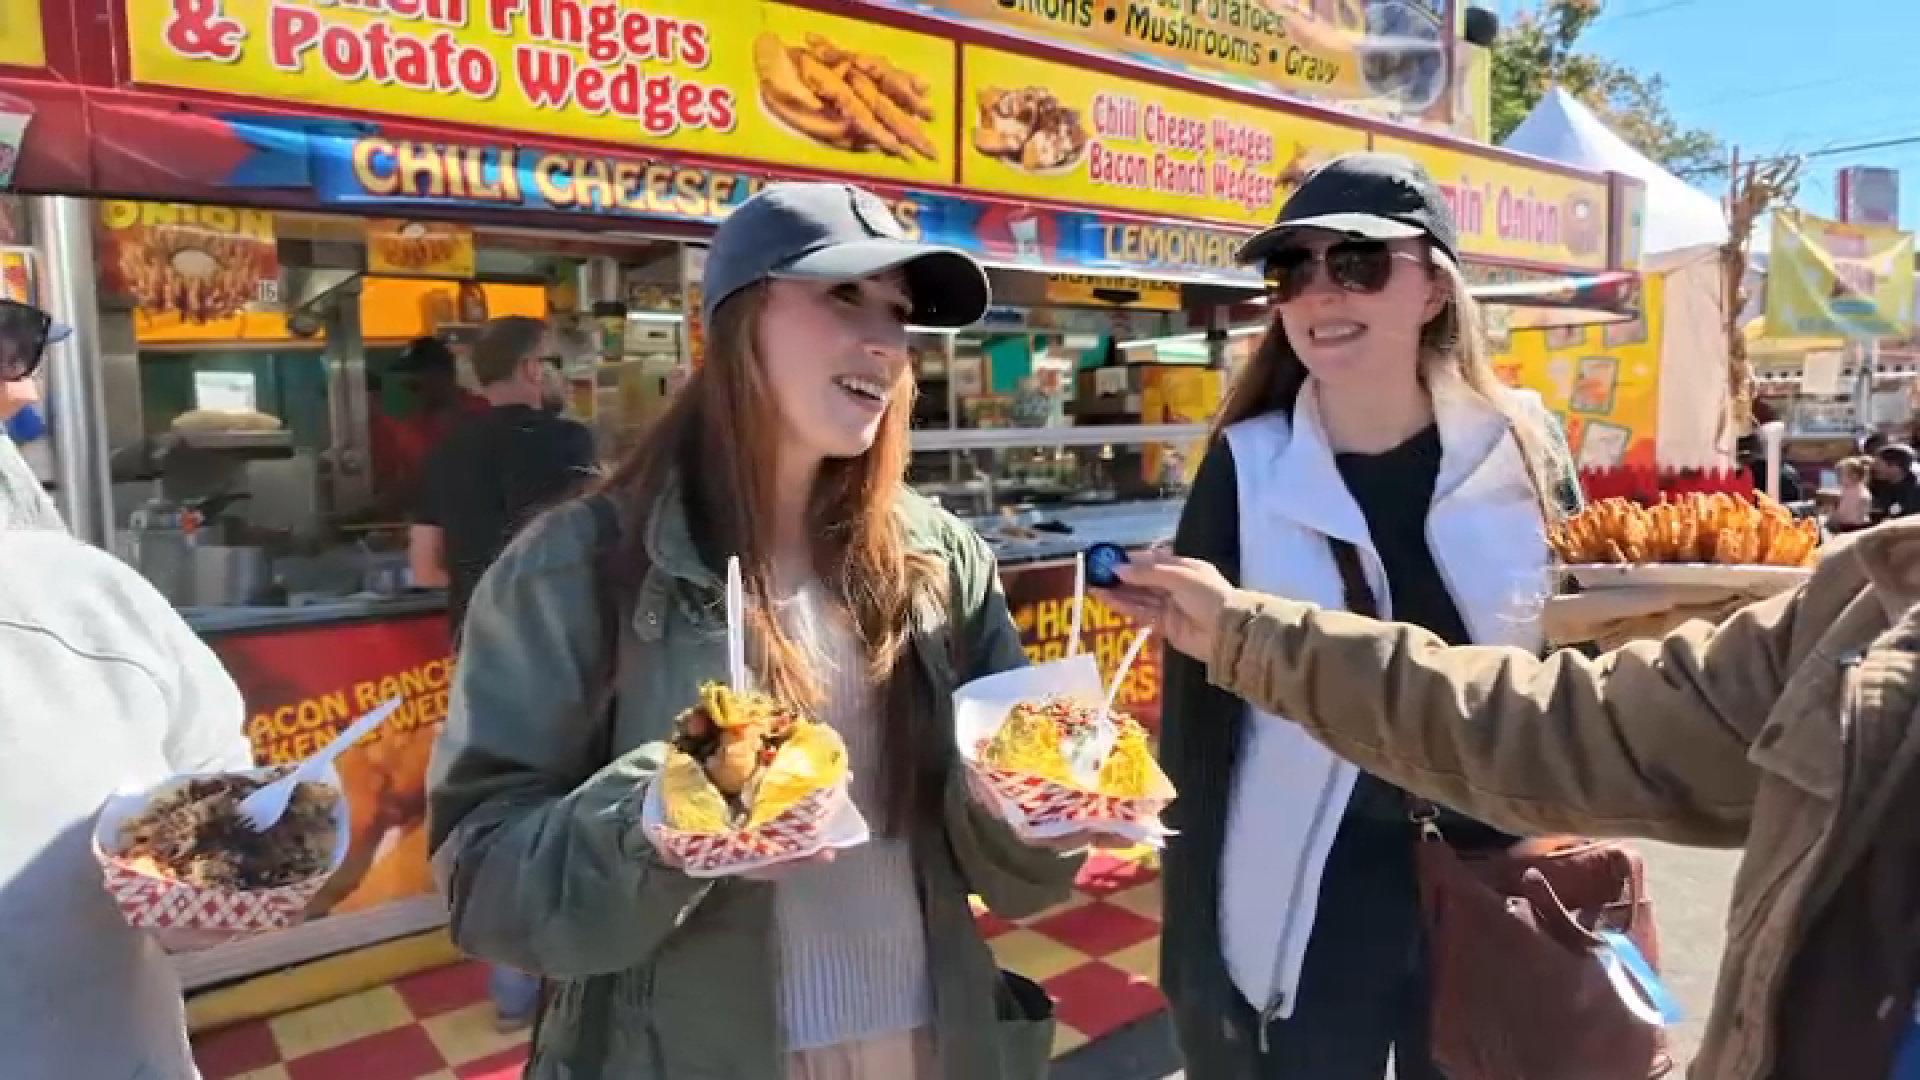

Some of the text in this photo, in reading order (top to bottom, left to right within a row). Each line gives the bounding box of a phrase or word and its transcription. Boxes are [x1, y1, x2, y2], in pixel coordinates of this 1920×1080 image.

[166, 0, 734, 133] & Potato Wedges
[489, 0, 706, 65] Fingers
[1002, 0, 1093, 27] nions
[1124, 3, 1261, 66] Mushrooms
[1284, 45, 1341, 84] Gravy
[1091, 92, 1276, 166] Chili Cheese Wedges
[352, 136, 520, 202] CHILI
[533, 153, 737, 217] CHEESE
[1089, 140, 1277, 211] Bacon Ranch Wedges
[1497, 185, 1559, 243] Onion
[1037, 594, 1126, 641] HONE
[247, 690, 348, 742] ACON
